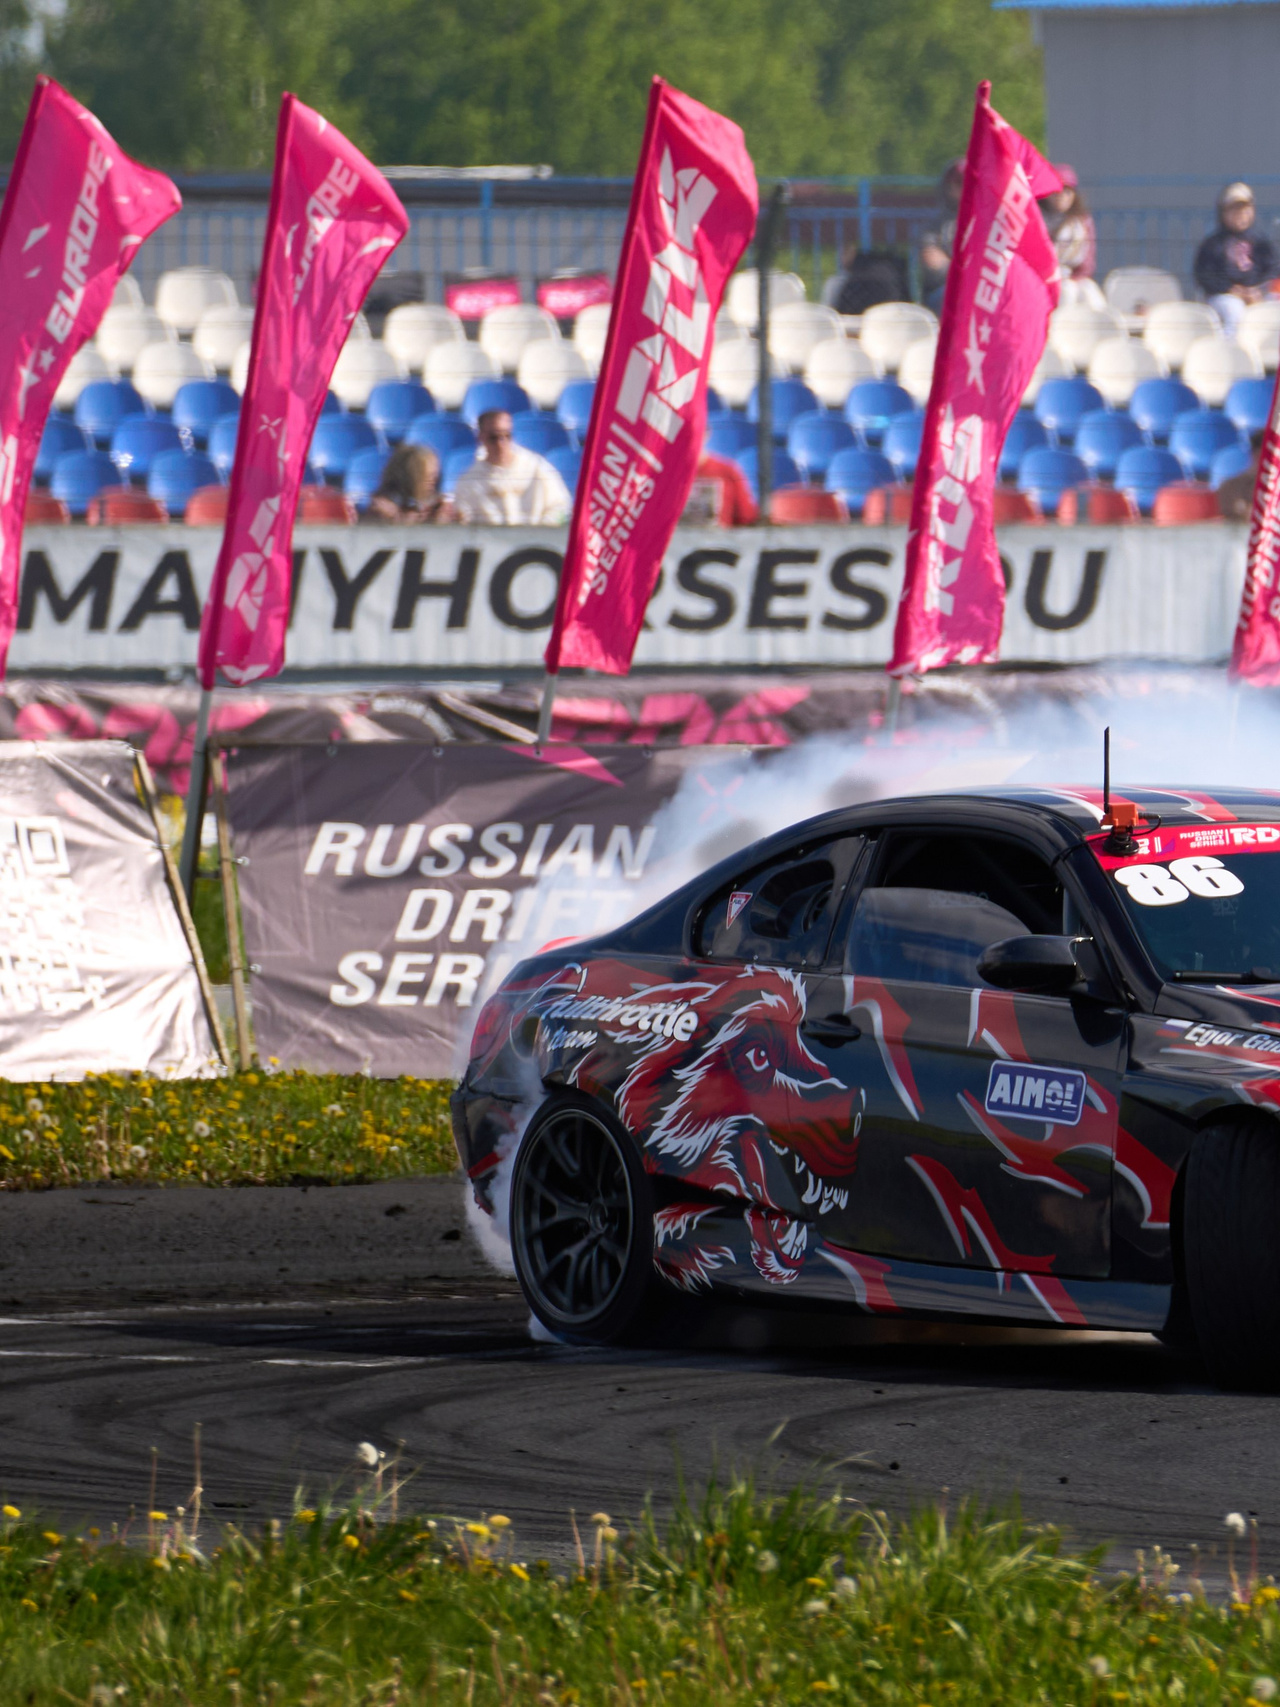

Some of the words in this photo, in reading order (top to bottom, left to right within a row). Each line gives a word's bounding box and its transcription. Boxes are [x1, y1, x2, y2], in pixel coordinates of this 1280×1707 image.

[45, 139, 113, 344] EUROPE
[304, 822, 656, 879] RUSSIAN
[1179, 828, 1224, 840] RUSSIAN
[1189, 839, 1225, 849] SERIES
[1195, 834, 1224, 843] DRIFT
[1114, 856, 1245, 906] 86
[394, 888, 637, 942] DRIFT
[1184, 1023, 1244, 1047] Egor
